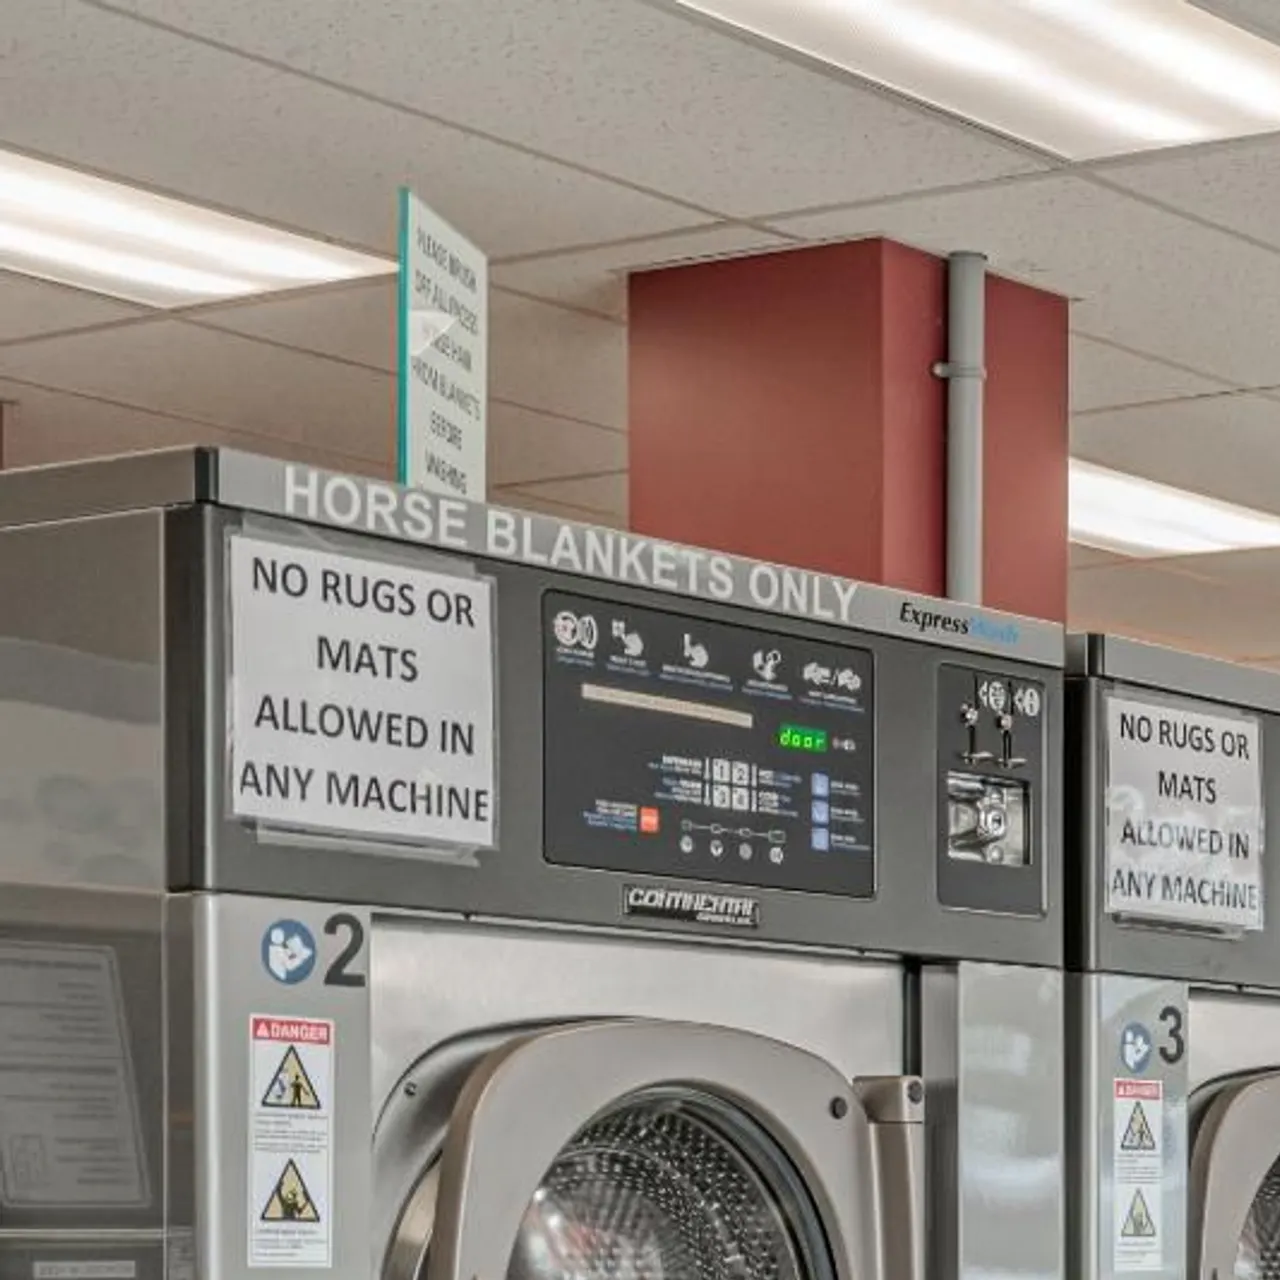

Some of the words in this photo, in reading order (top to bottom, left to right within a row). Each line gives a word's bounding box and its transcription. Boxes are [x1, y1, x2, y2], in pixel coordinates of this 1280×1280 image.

[285, 465, 469, 548] HORSE
[487, 510, 734, 599] BLANKETS
[748, 562, 860, 623] ONLY
[251, 556, 308, 597] NO
[321, 571, 417, 618] RUGS
[426, 588, 476, 628] OR
[316, 635, 419, 683] MATS
[254, 694, 429, 752] ALLOWED
[439, 718, 475, 756] IN
[1119, 712, 1153, 744] NO
[1157, 719, 1216, 754] RUGS
[1221, 733, 1251, 761] OR
[239, 760, 315, 804] ANY
[325, 772, 490, 823] MACHINE
[1157, 770, 1217, 805] MATS
[1120, 817, 1224, 856] ALLOWED
[1228, 830, 1251, 860] IN
[1111, 868, 1156, 900] ANY
[1161, 873, 1258, 912] MACHINE
[323, 912, 366, 988] 2
[271, 1022, 328, 1041] DANGER
[1158, 1004, 1185, 1065] 3
